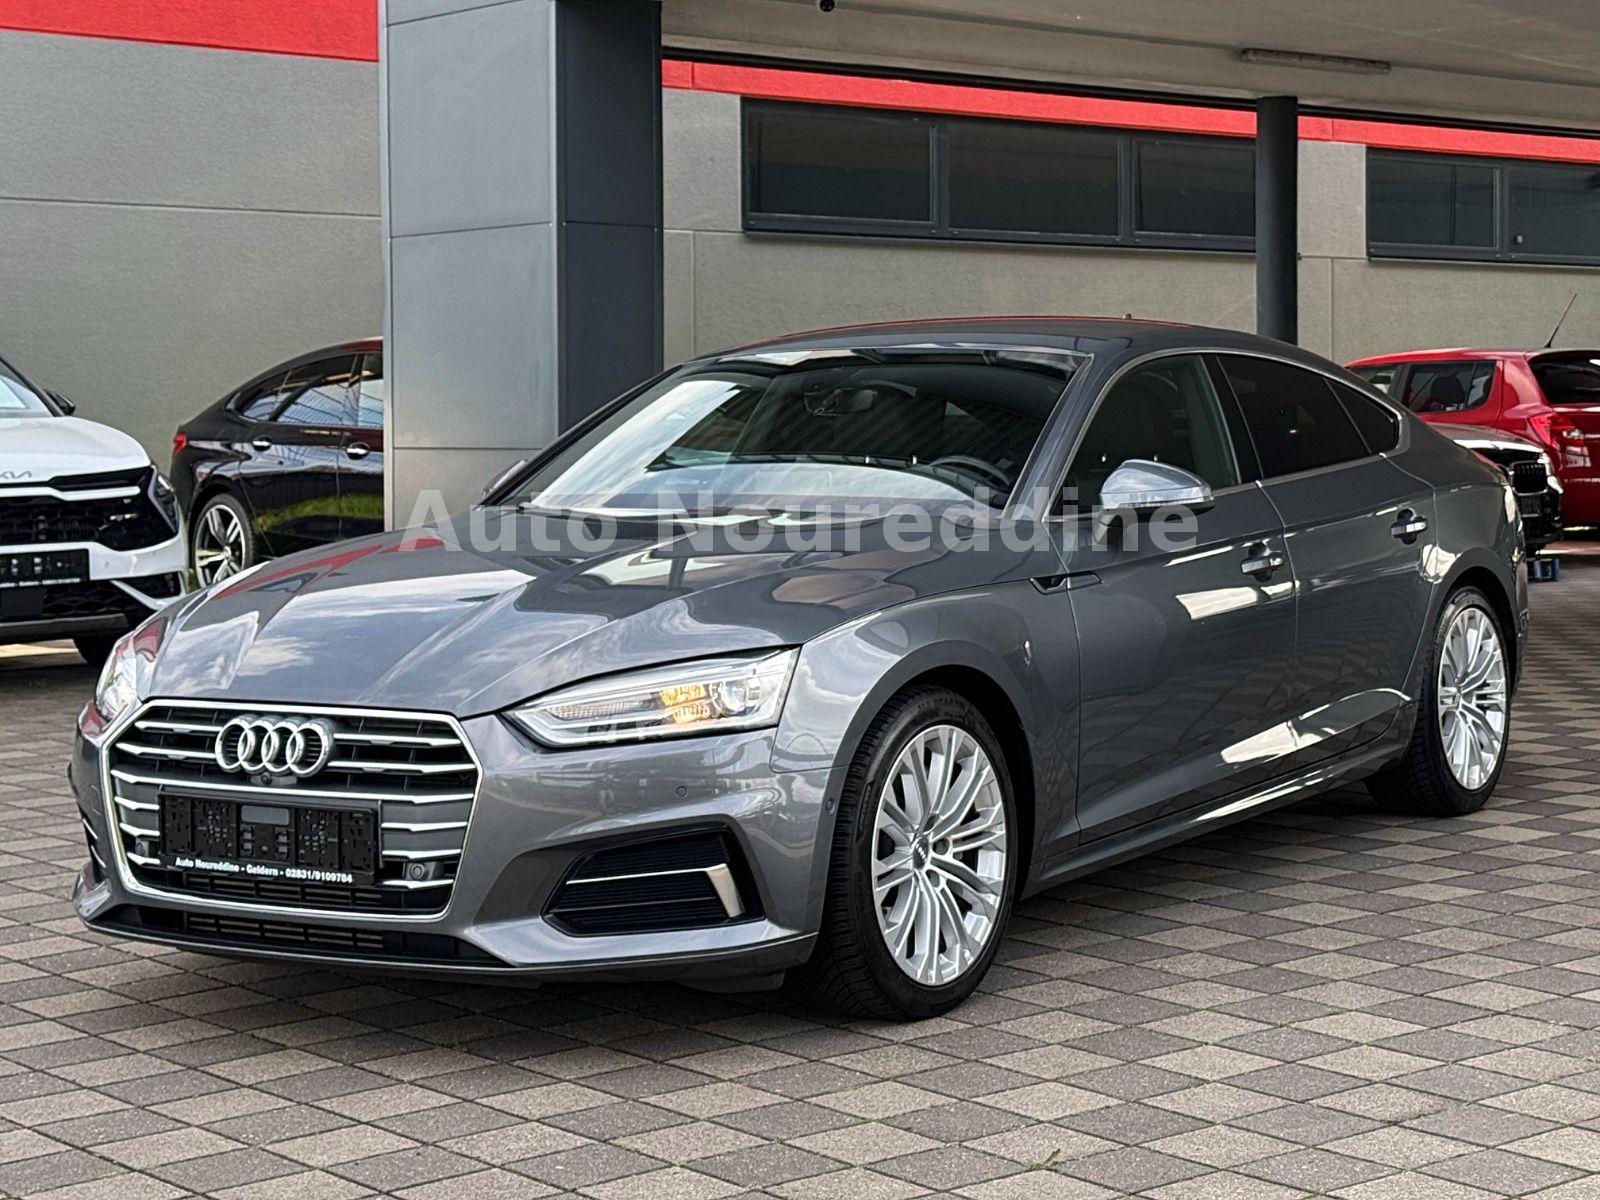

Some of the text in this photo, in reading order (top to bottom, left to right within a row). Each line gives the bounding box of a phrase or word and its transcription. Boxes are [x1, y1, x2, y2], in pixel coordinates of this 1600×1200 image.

[175, 856, 194, 867] Auto
[195, 858, 239, 872] Noureddine
[246, 864, 278, 876] Geldern
